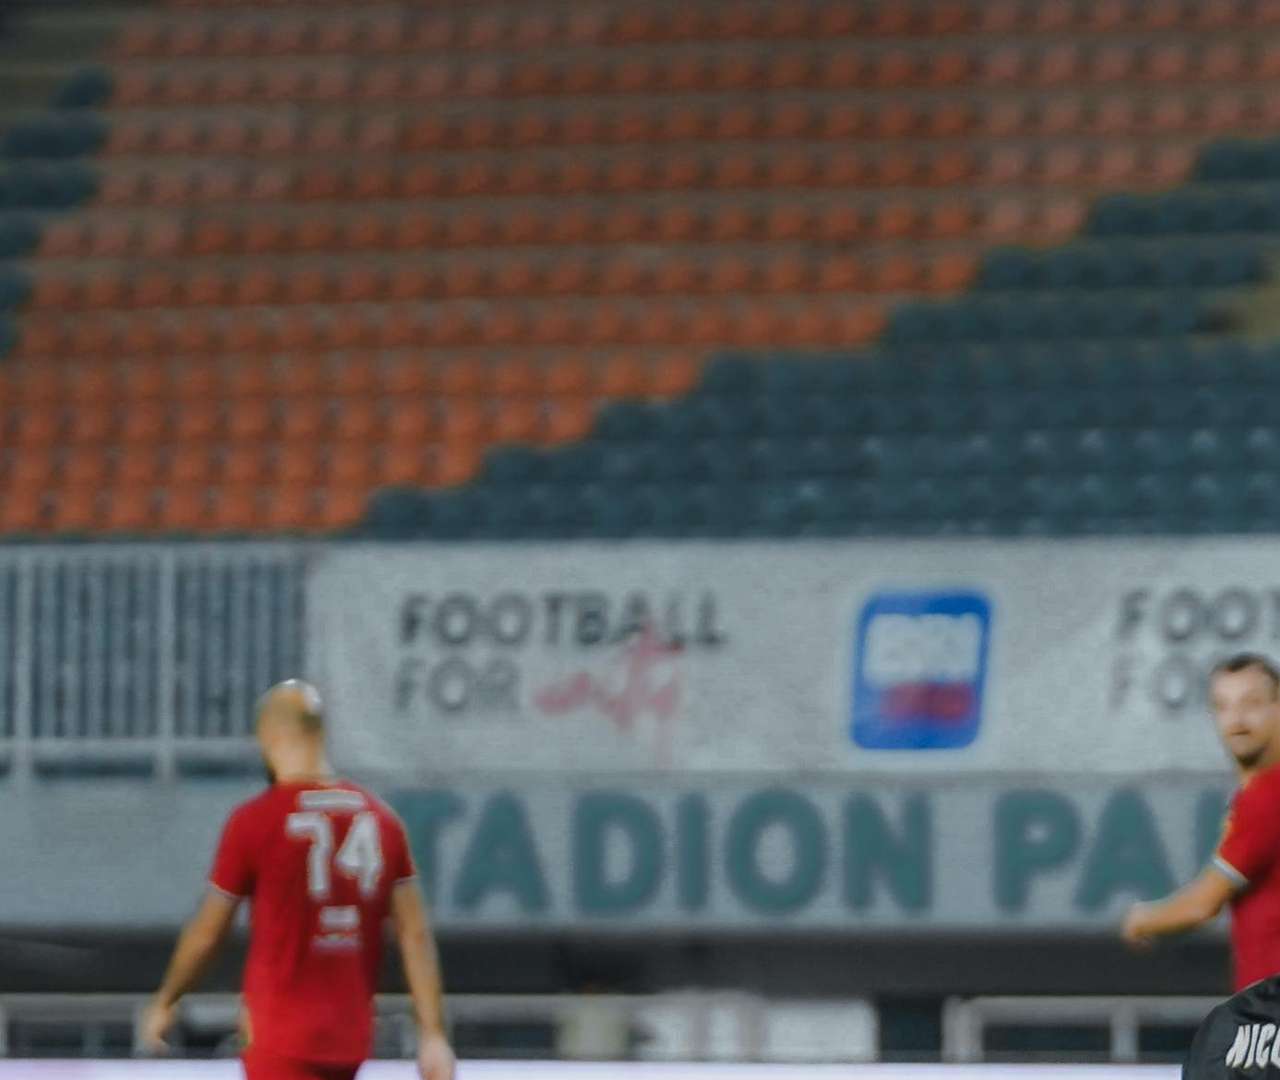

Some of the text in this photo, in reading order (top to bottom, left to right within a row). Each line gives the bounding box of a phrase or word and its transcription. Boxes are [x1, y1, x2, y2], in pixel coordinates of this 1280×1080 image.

[398, 590, 729, 650] FOOTBALL
[395, 655, 522, 716] FOR
[284, 810, 384, 899] 74
[393, 788, 934, 914] TADION
